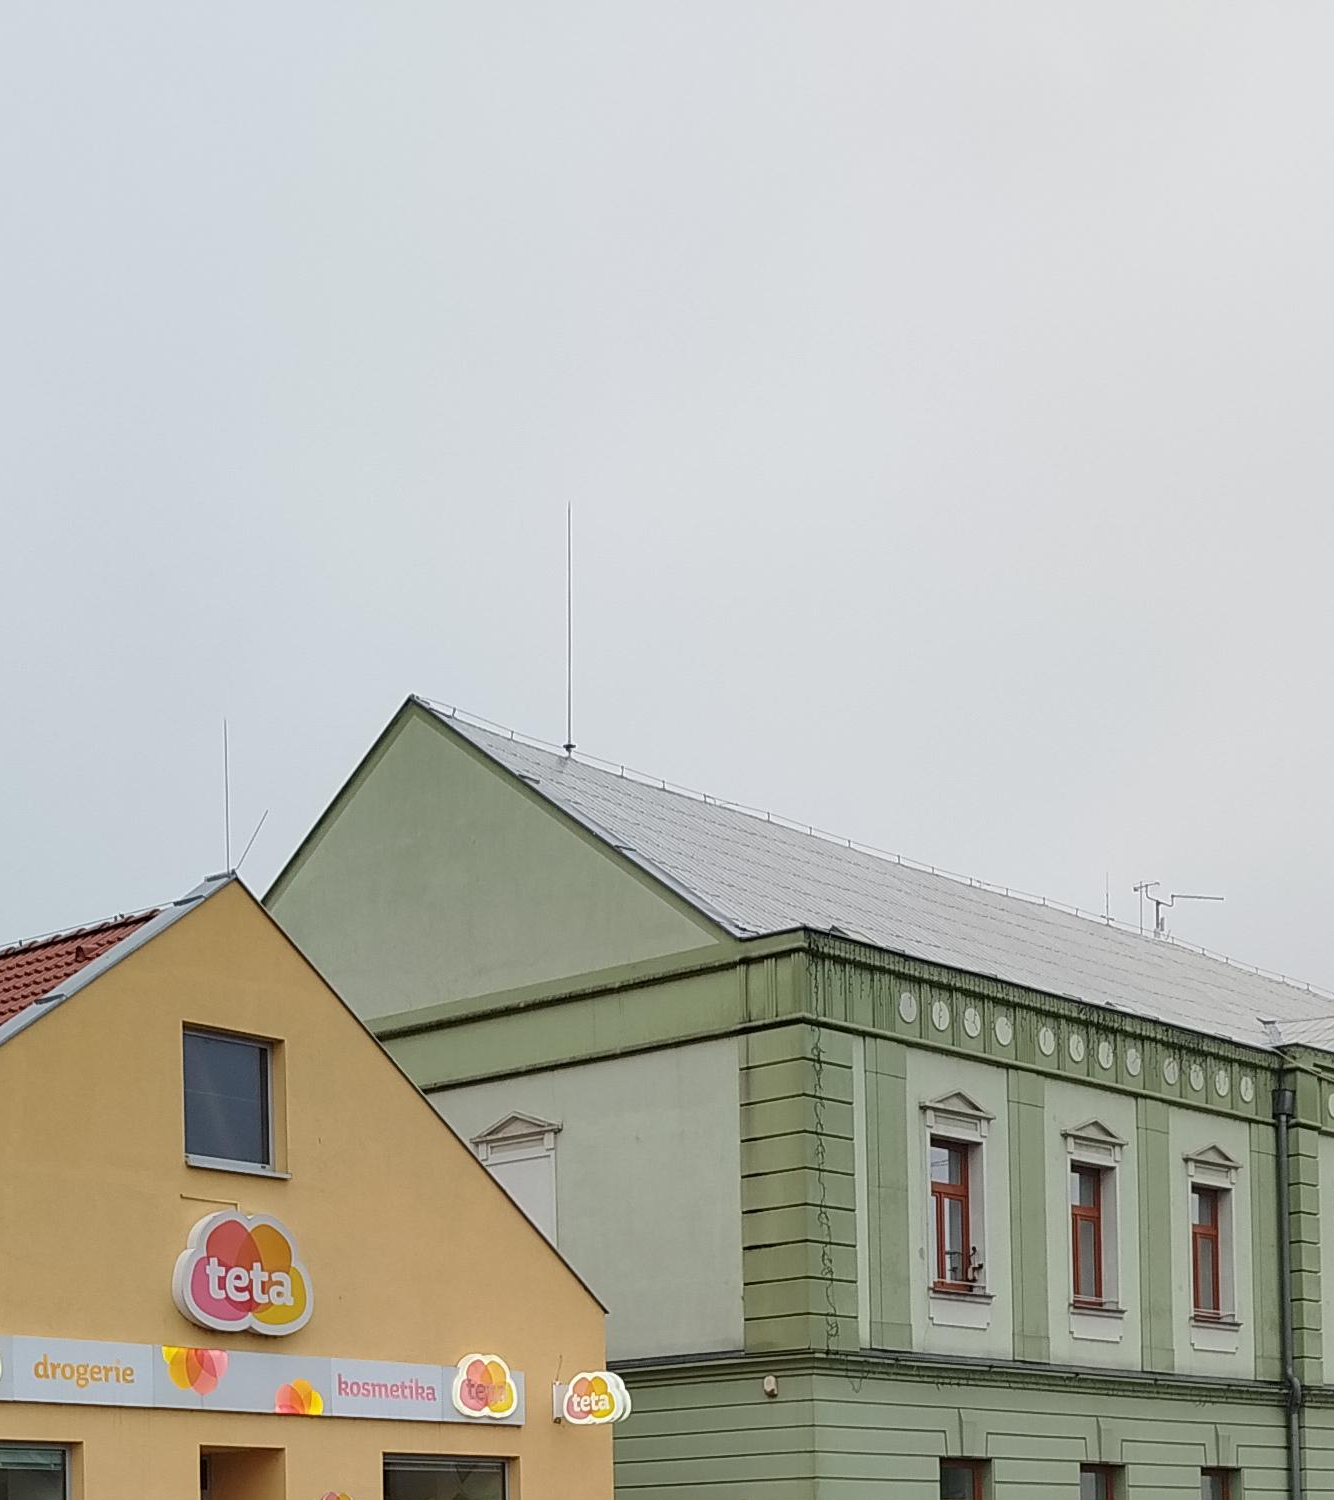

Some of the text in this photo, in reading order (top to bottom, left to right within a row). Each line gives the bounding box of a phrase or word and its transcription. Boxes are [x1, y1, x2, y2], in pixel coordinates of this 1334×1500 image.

[206, 1257, 294, 1306] teta
[34, 1353, 135, 1388] drogerie
[337, 1373, 437, 1402] kosmetika
[466, 1378, 508, 1404] teta
[571, 1391, 610, 1413] teta
